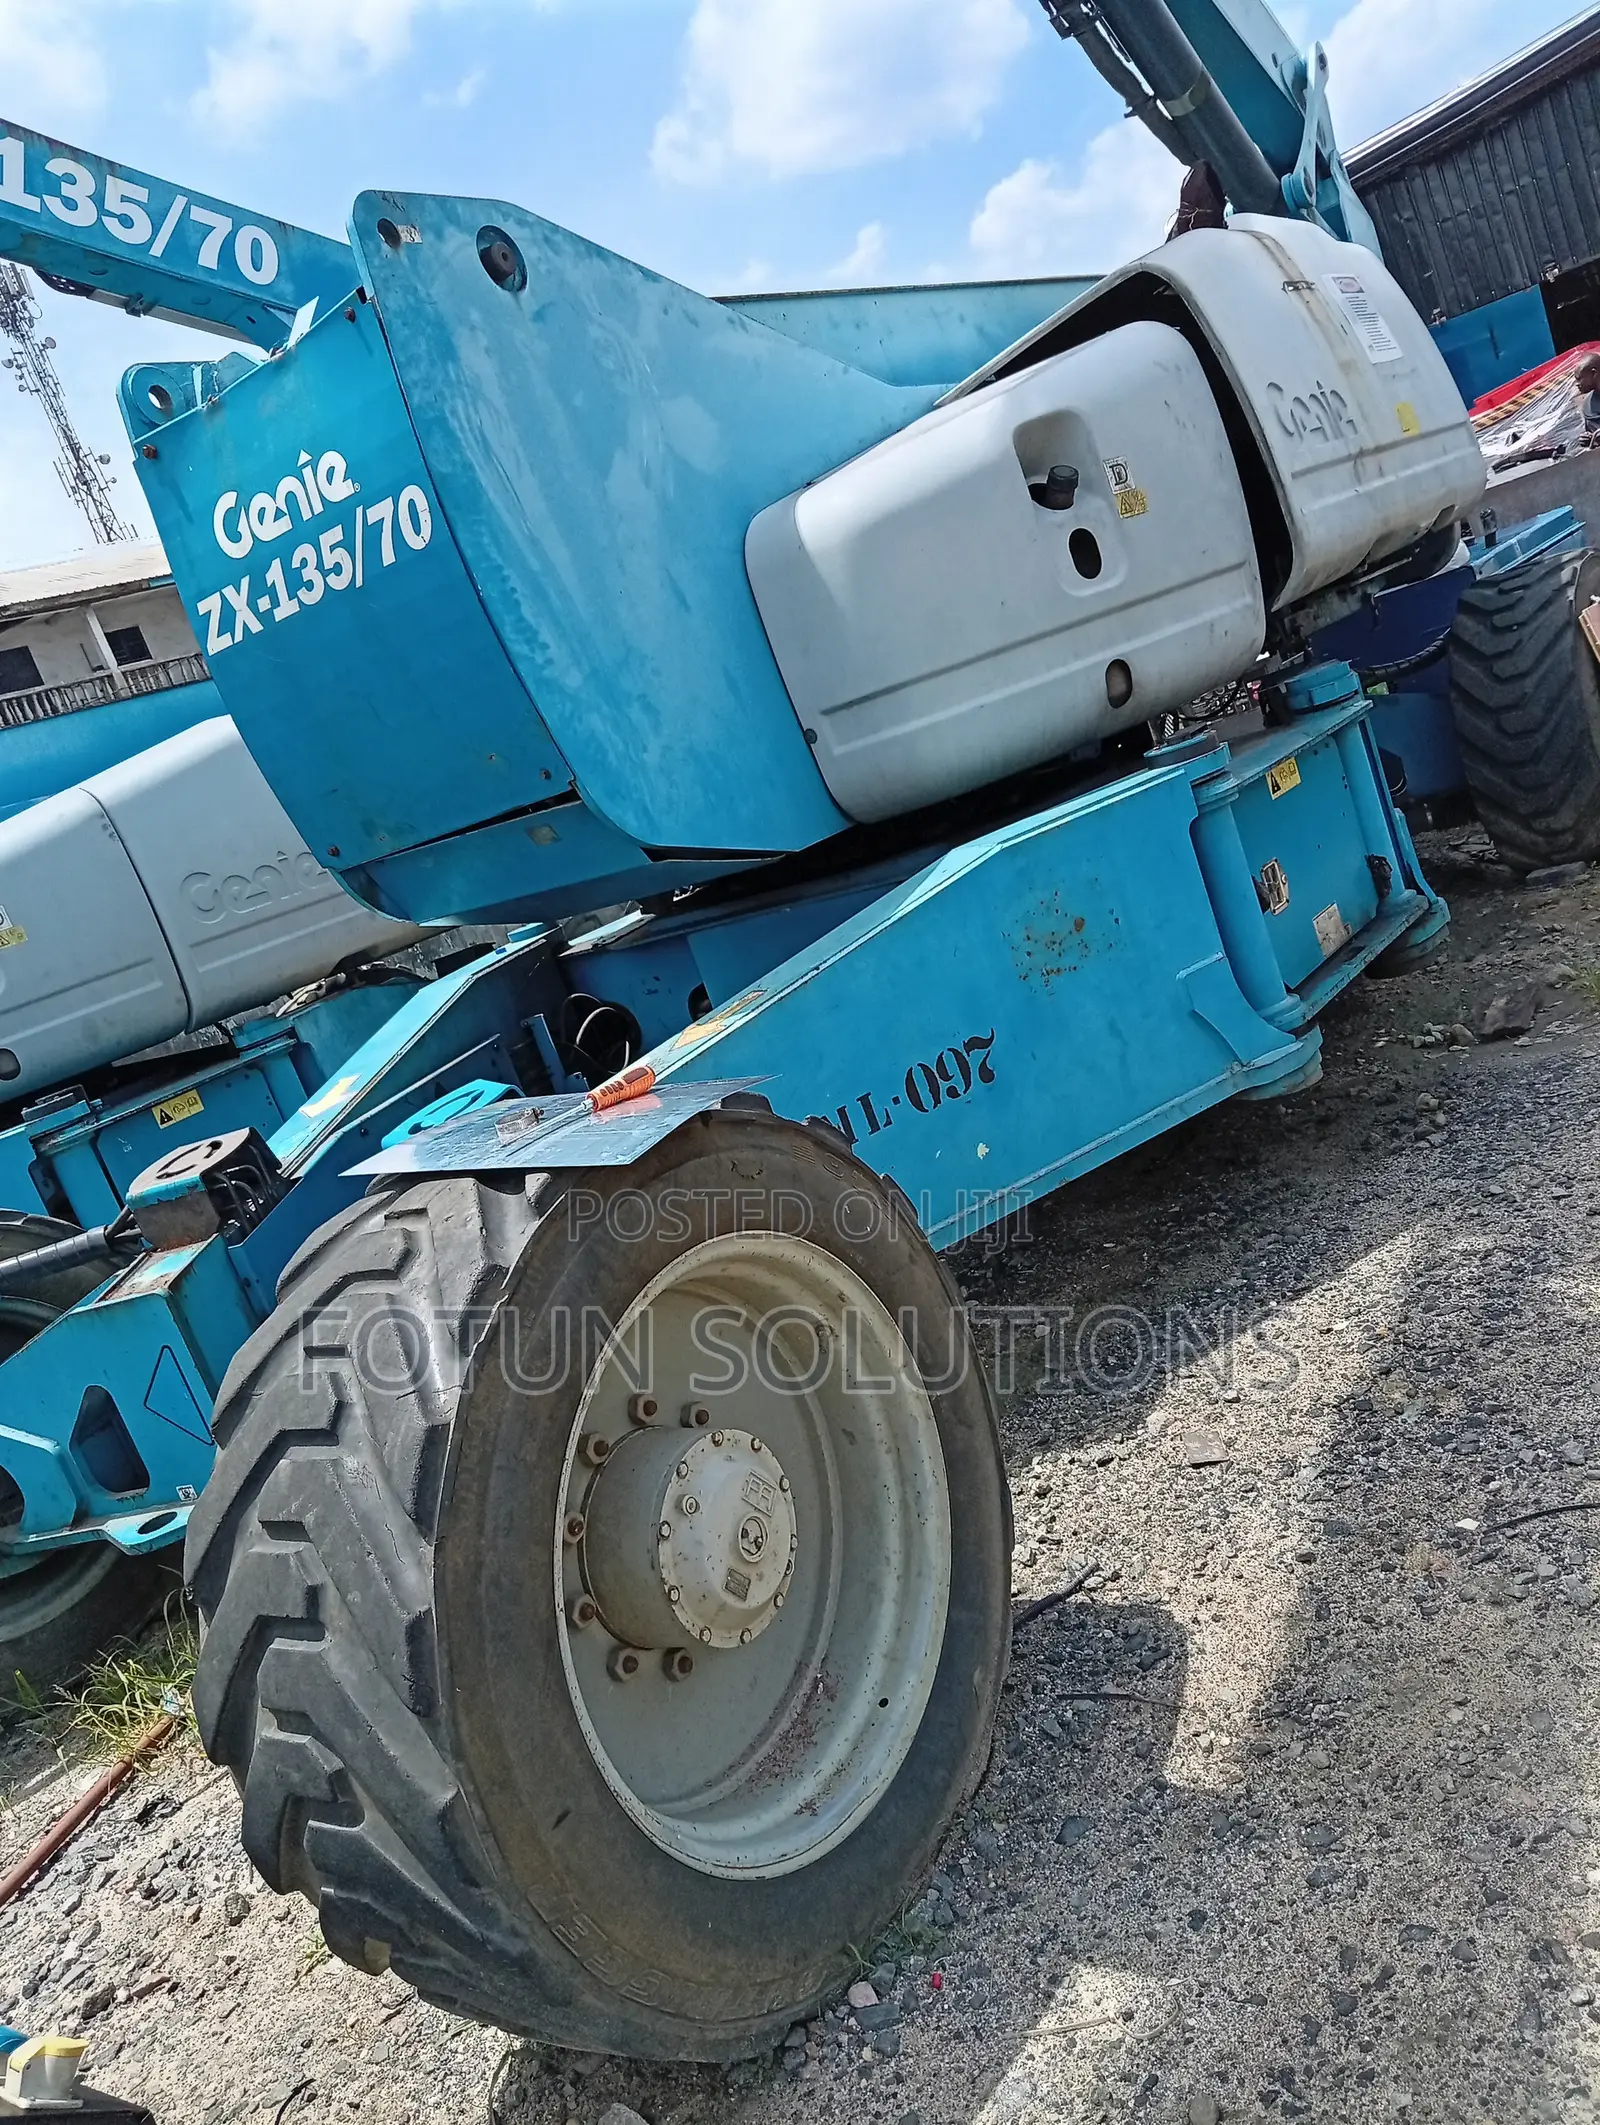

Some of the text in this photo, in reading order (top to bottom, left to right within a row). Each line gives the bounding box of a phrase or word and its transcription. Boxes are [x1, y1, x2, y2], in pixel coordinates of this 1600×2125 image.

[1267, 381, 1358, 442] Genie
[213, 449, 356, 559] Genie
[197, 484, 432, 656] ZX-135/70
